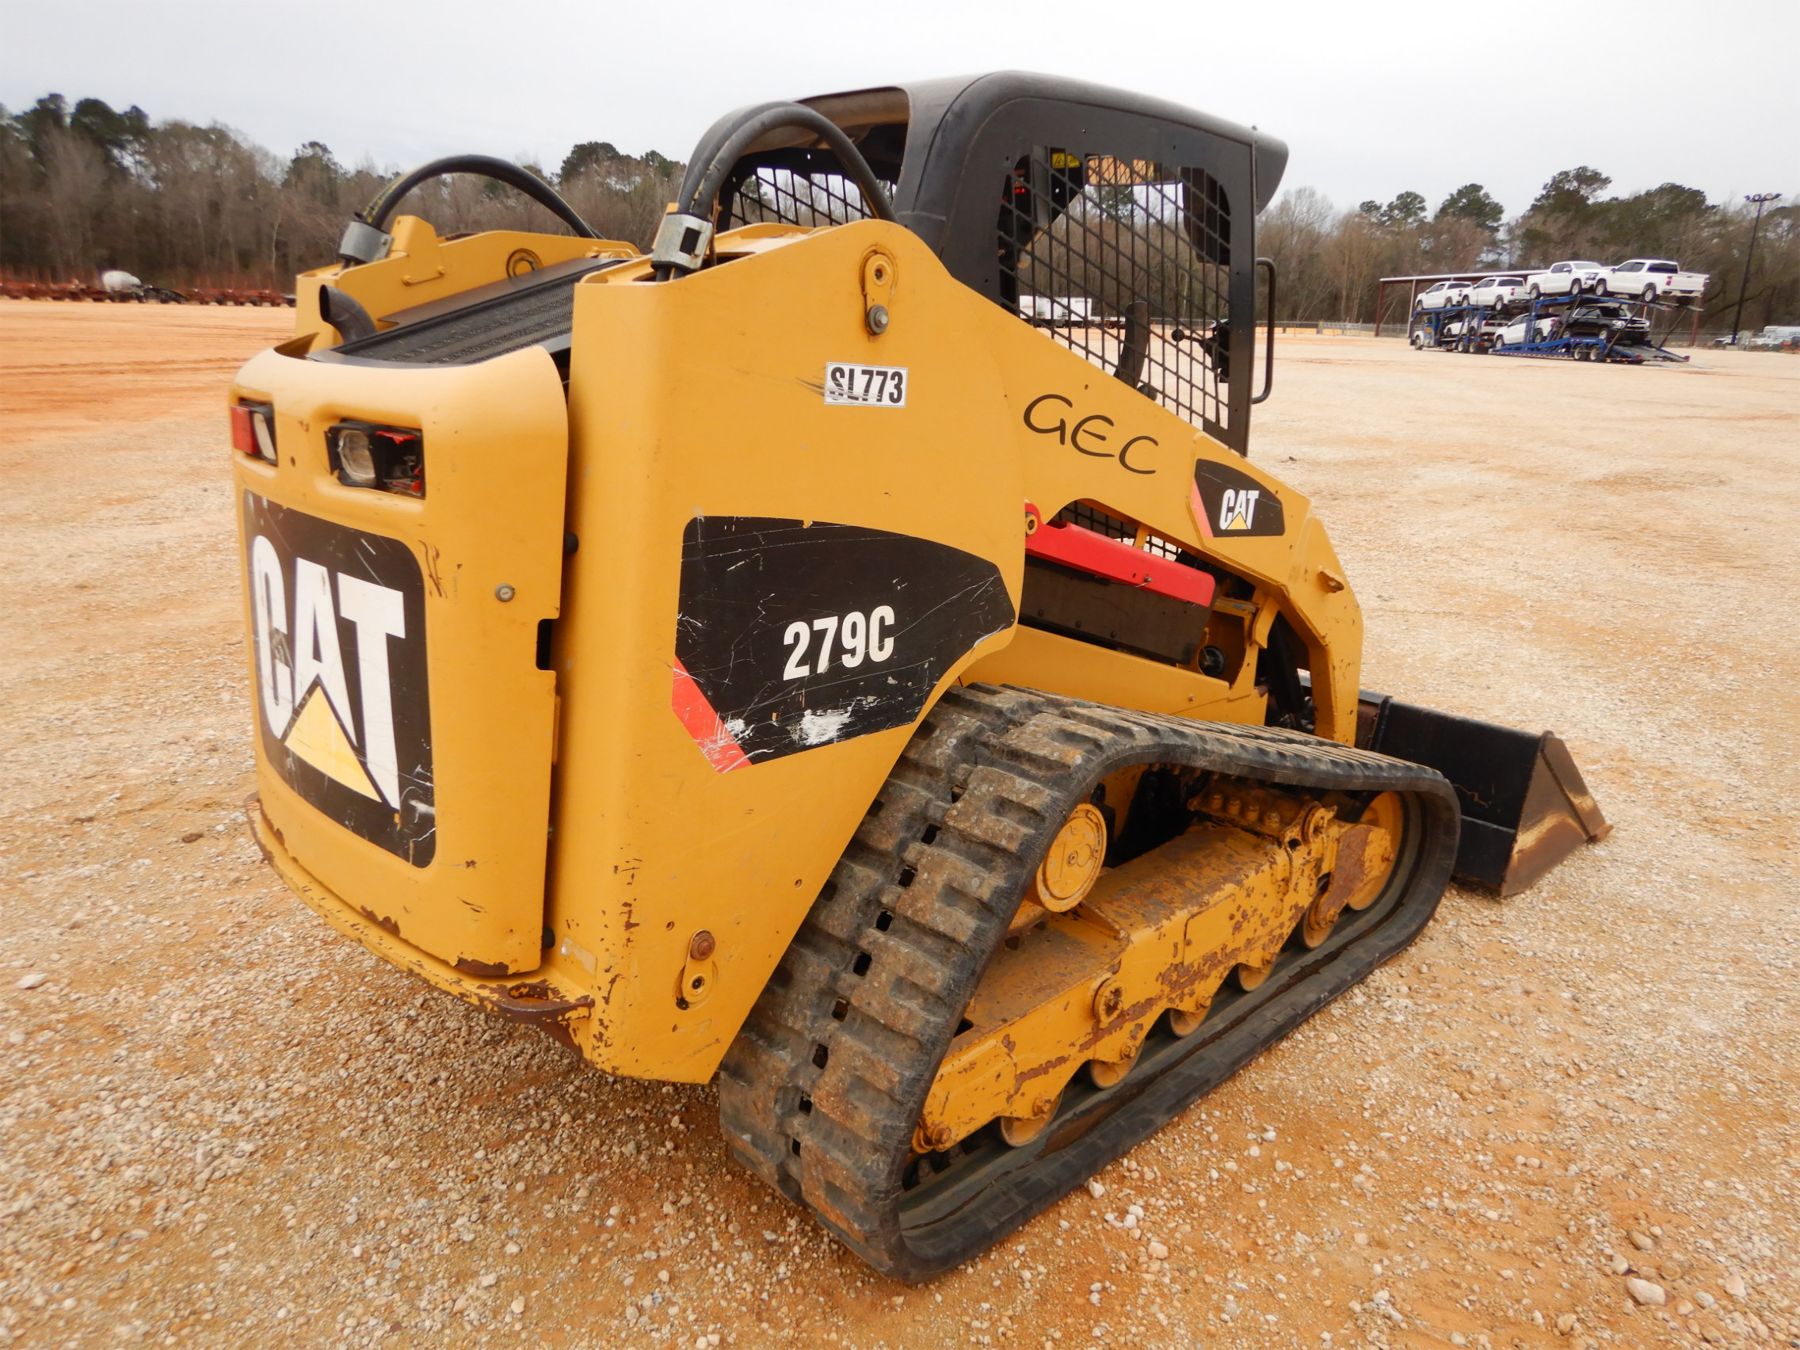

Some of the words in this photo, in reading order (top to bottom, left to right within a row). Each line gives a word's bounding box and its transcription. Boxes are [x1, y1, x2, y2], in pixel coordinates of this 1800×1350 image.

[829, 366, 904, 404] SL773
[1023, 393, 1159, 475] GEC
[1219, 488, 1260, 530] CAT
[252, 534, 406, 811] CAT
[783, 605, 895, 681] 279C
